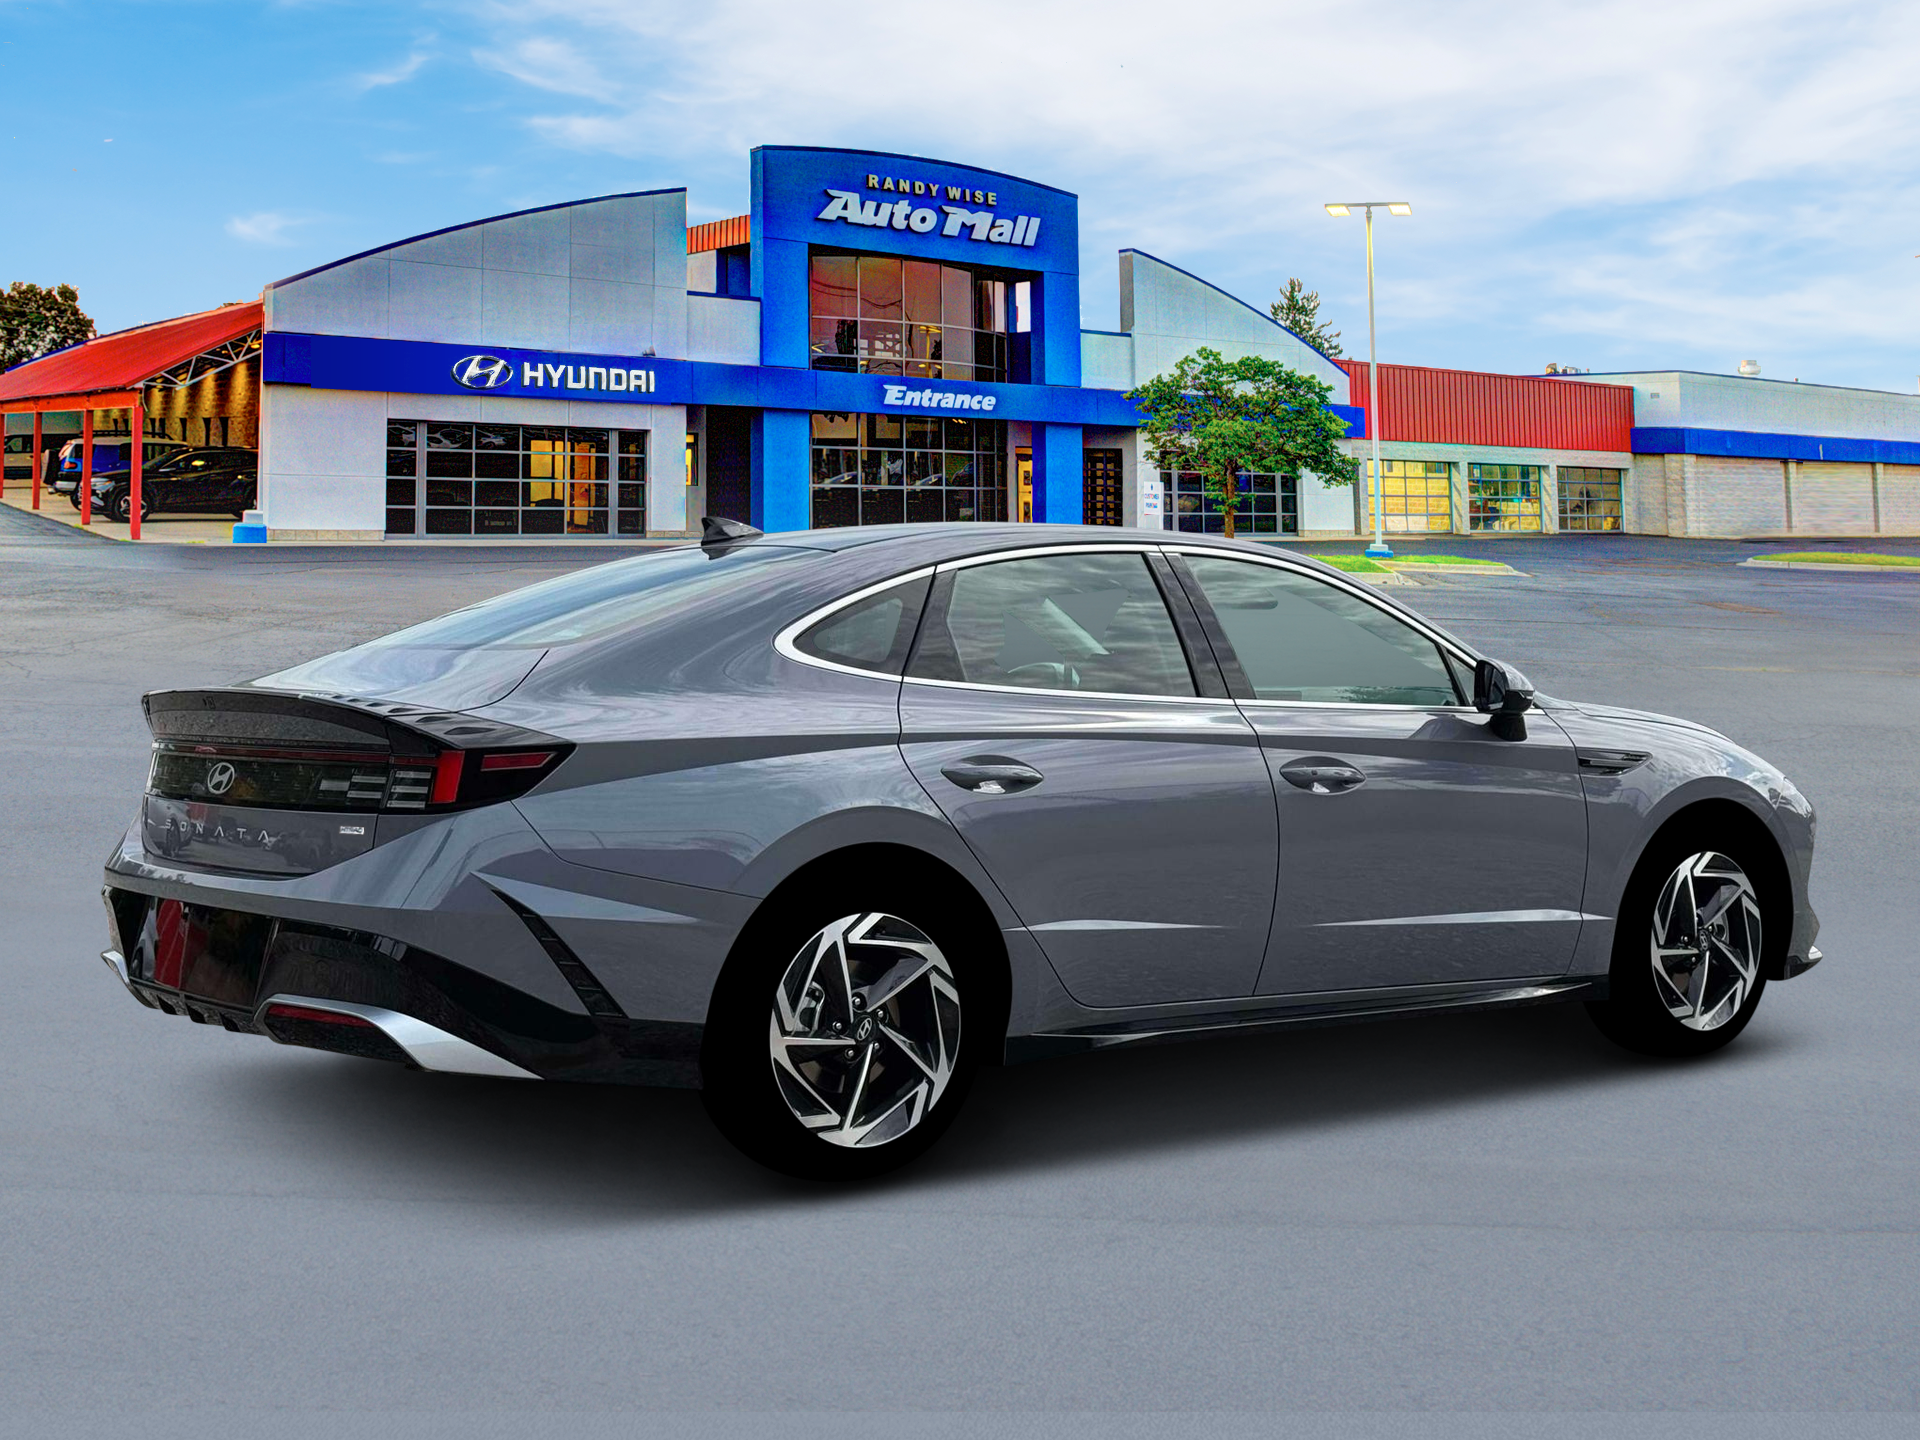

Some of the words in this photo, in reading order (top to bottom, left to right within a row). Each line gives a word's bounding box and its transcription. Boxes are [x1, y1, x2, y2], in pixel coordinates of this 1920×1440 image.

[867, 173, 940, 196] RANDY
[946, 186, 997, 205] WISE
[817, 189, 938, 233] Auto
[941, 205, 1041, 246] Mall
[522, 361, 655, 393] HYUNDAI
[882, 384, 996, 411] Entrance
[164, 819, 270, 841] SONATA
